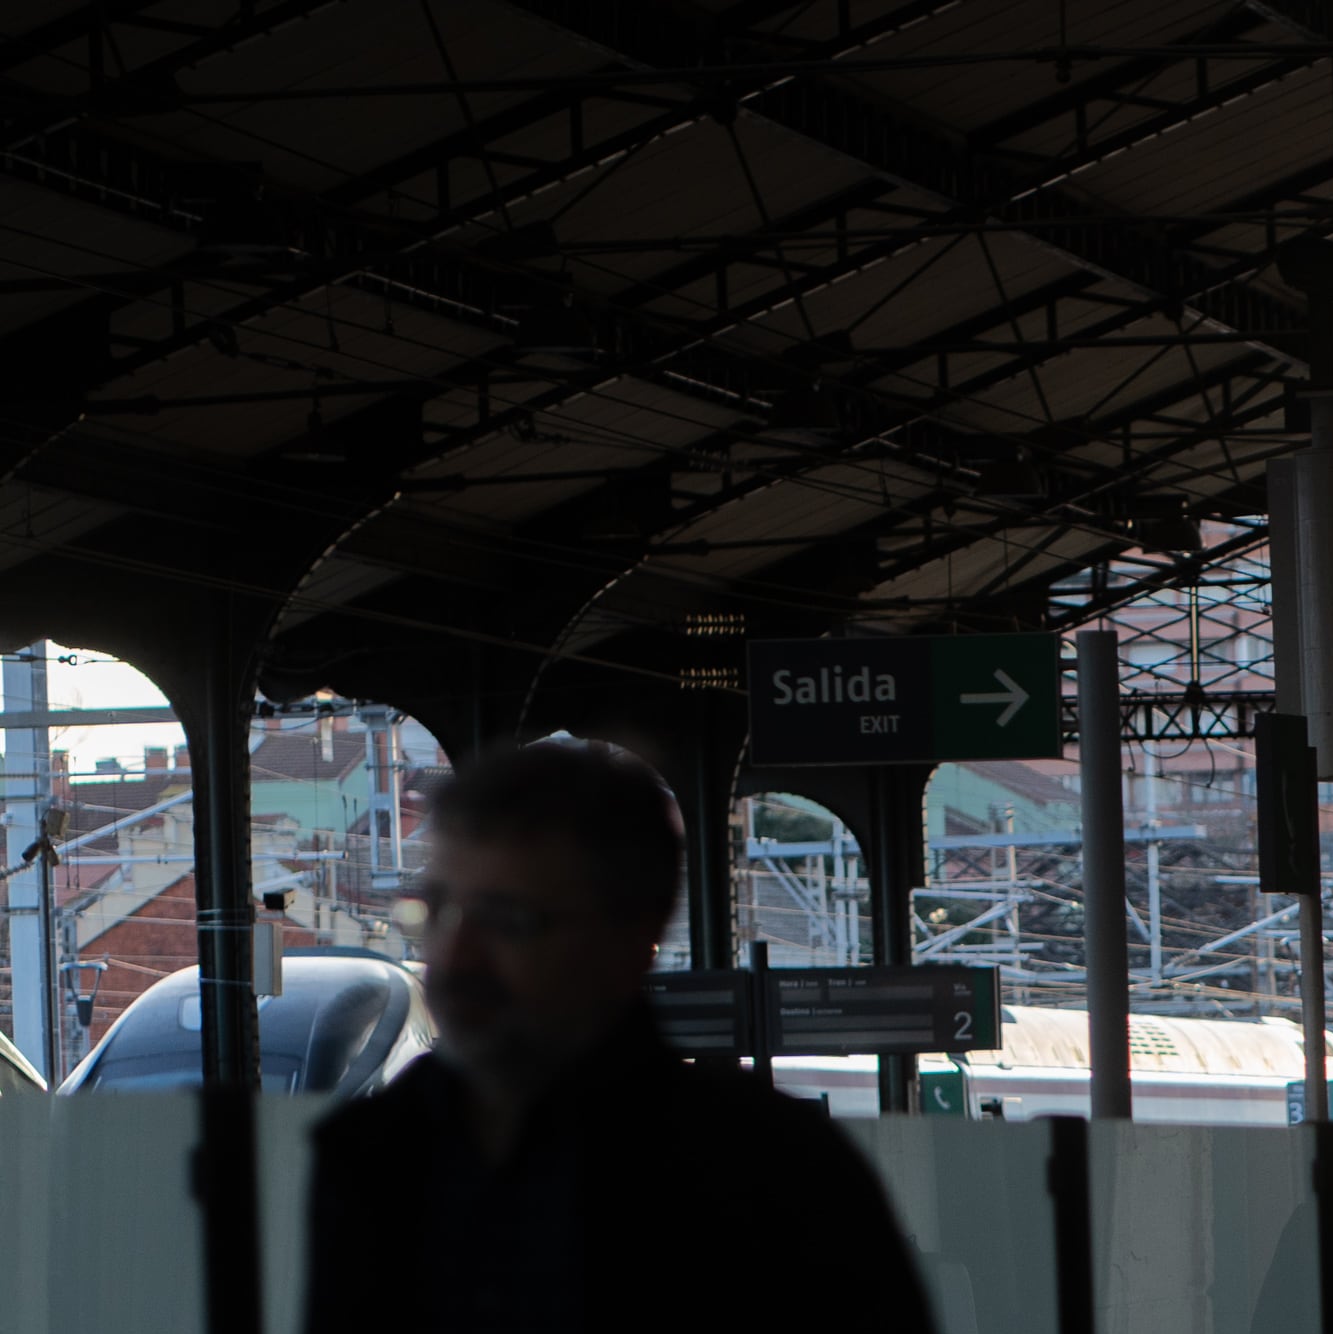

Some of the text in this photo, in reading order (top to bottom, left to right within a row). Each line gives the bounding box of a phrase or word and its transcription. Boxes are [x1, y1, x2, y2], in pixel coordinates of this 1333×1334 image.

[772, 664, 897, 706] Salida
[860, 714, 901, 735] EXIT
[953, 1010, 973, 1041] 2
[1289, 1101, 1305, 1125] 3
